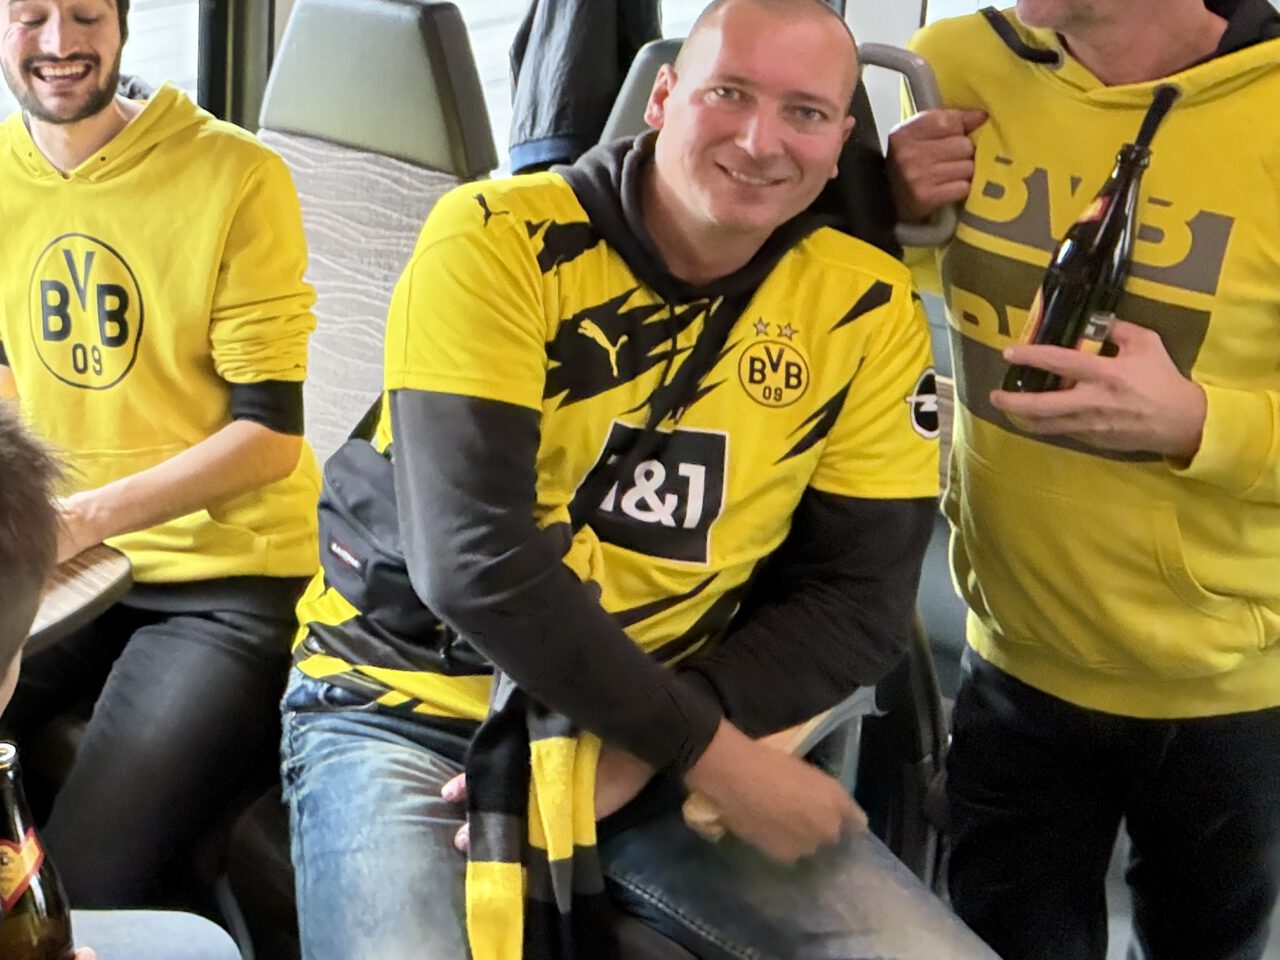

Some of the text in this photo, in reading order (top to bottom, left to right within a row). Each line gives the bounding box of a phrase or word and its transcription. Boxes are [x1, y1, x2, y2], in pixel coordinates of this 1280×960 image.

[40, 248, 129, 348] BVB
[72, 343, 103, 376] 09
[748, 344, 803, 390] BVB
[762, 385, 783, 402] 09
